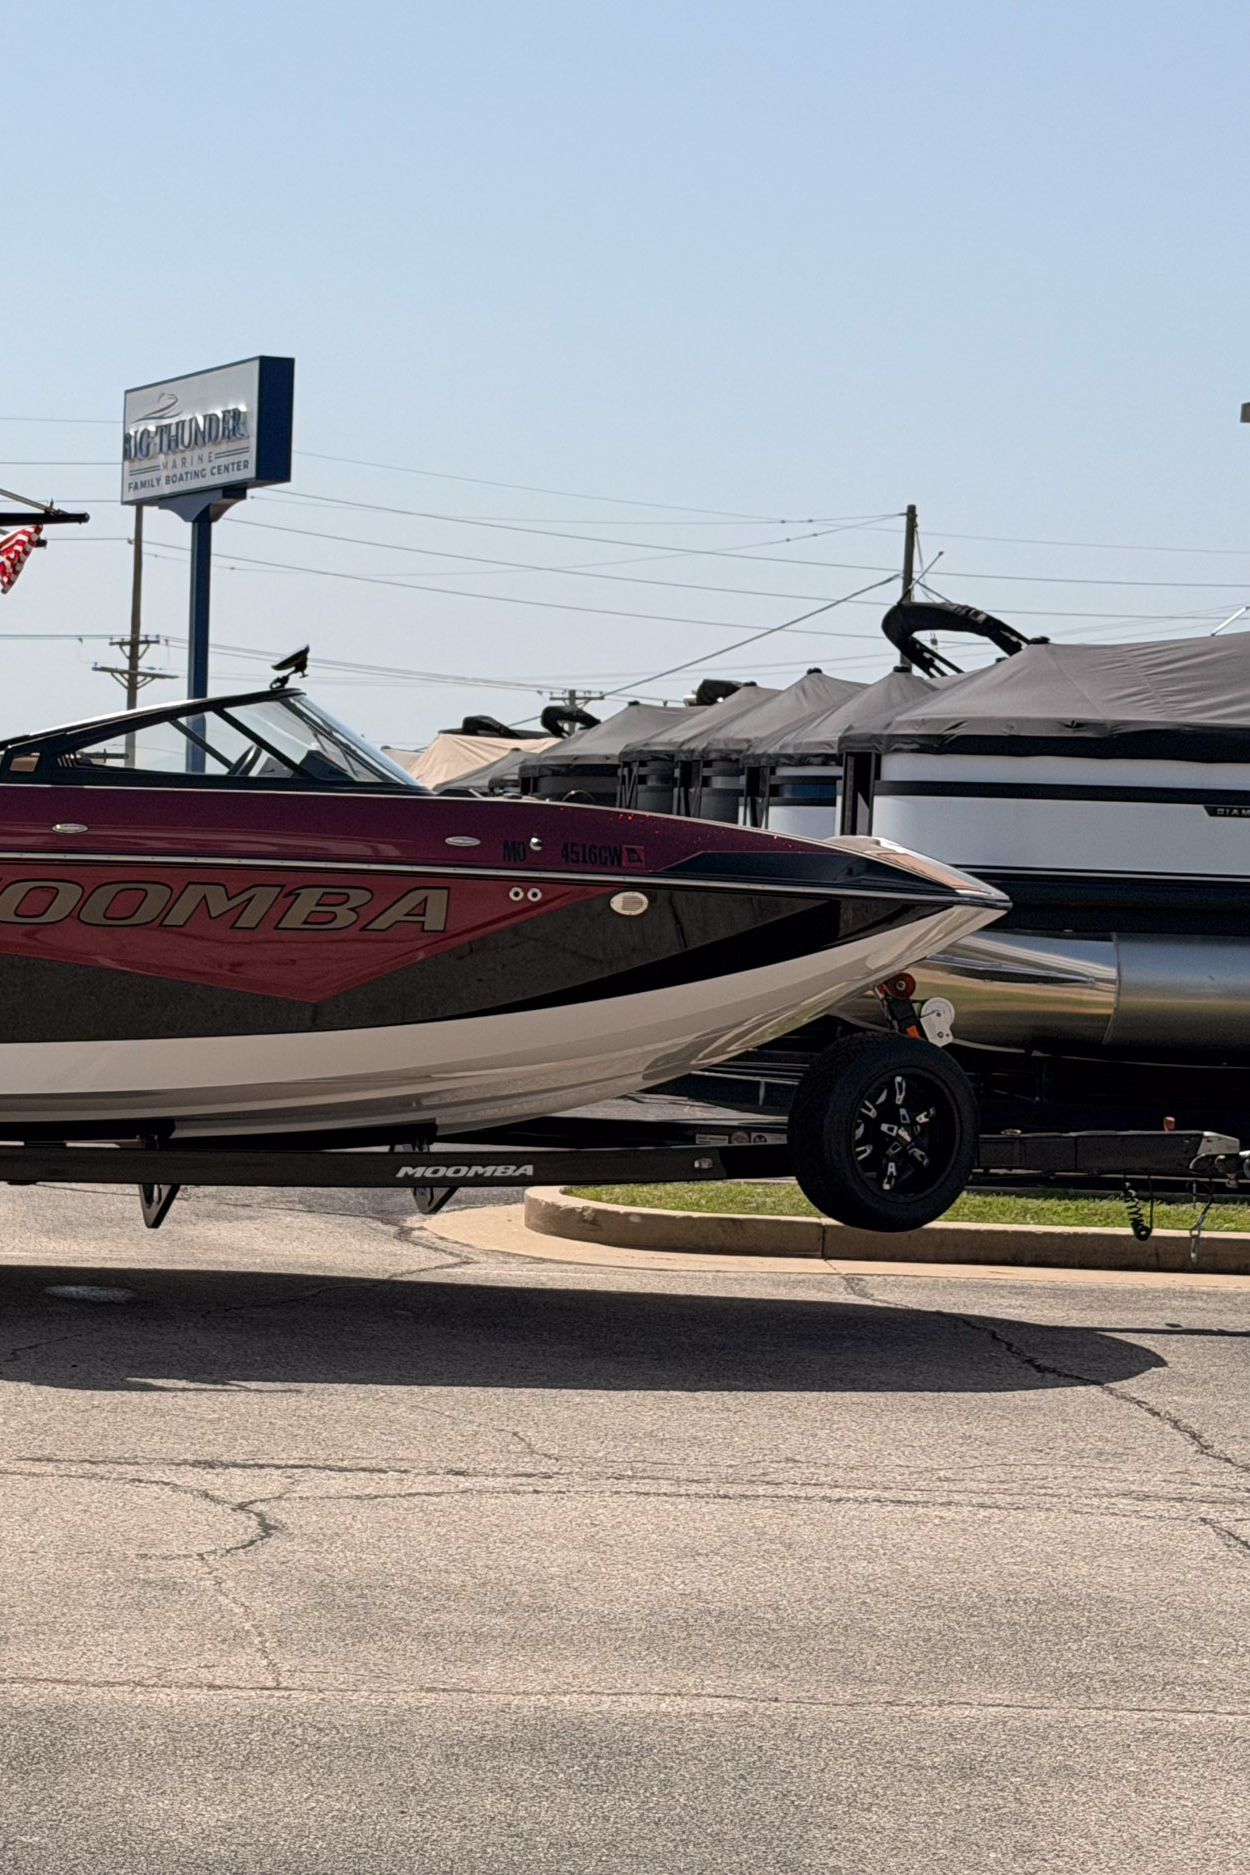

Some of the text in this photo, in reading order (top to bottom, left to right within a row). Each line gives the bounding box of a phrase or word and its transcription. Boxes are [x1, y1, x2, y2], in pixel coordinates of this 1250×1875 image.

[154, 407, 245, 455] THUNDER
[162, 451, 214, 470] MARINE
[128, 460, 250, 492] FAMILY BOATING CENTER
[503, 840, 527, 863] MO
[395, 1164, 534, 1178] MOOMBA
